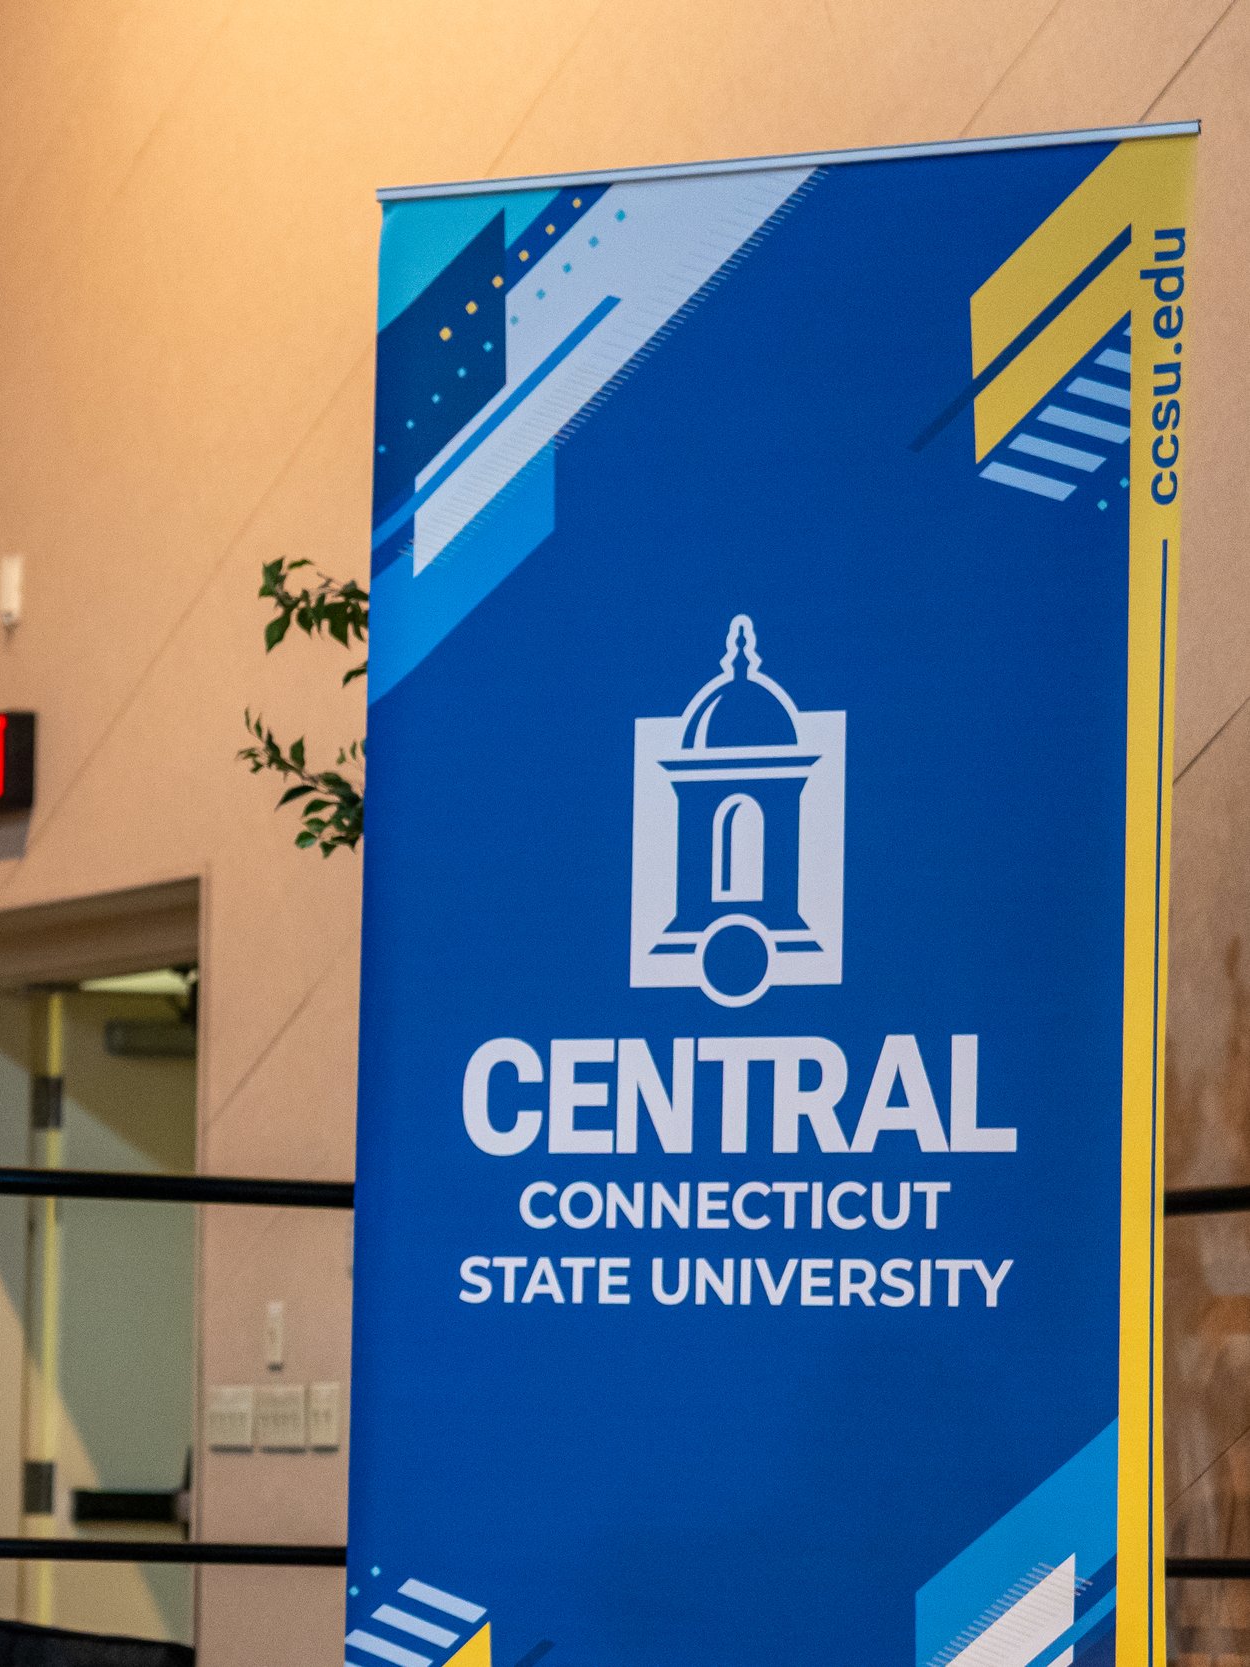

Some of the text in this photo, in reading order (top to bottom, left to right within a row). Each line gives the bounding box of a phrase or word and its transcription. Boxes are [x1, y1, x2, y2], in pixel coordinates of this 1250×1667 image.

[1140, 227, 1186, 506] ccsu.edu
[462, 1034, 1017, 1156] CENTRAL
[519, 1181, 951, 1230] CONNECTICUT
[459, 1256, 1014, 1308] STATE UNIVERSITY
